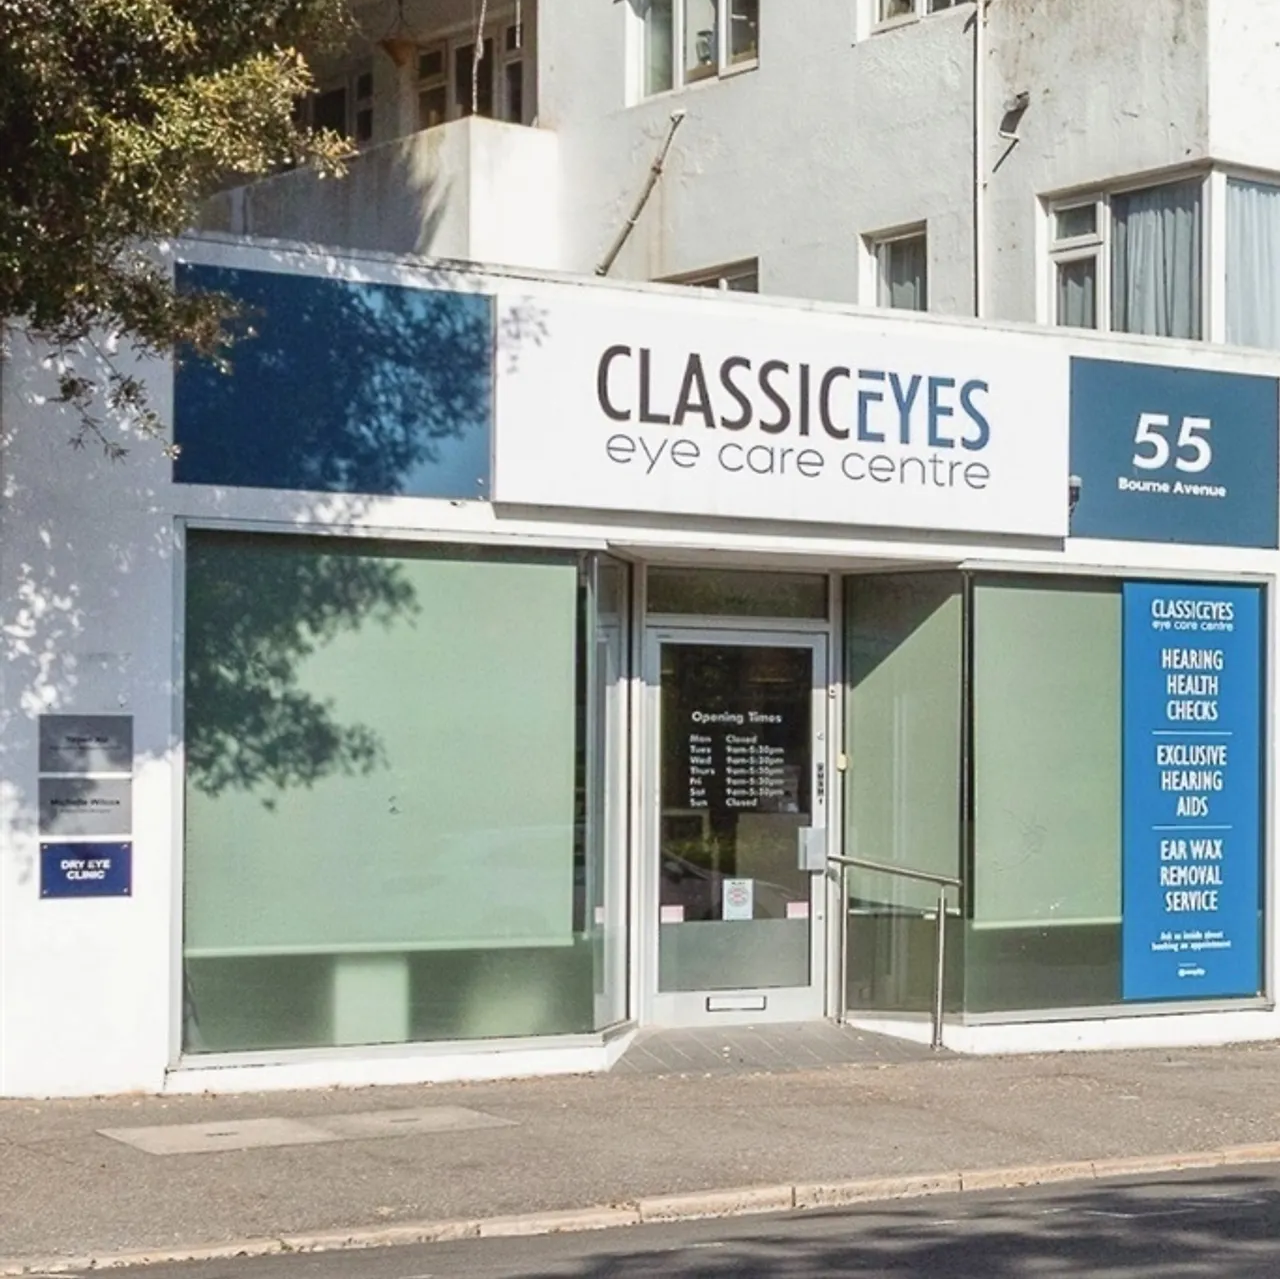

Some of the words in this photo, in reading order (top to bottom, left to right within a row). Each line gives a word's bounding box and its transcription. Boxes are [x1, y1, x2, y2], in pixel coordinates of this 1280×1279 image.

[597, 344, 991, 451] CLASSICEYES
[1132, 412, 1212, 473] 55
[606, 433, 700, 475] eye
[718, 442, 825, 477] care
[841, 452, 991, 489] centre
[1118, 476, 1170, 493] Bourne
[1173, 481, 1227, 497] Avenue
[1151, 599, 1234, 620] CLASSICEYES
[1152, 621, 1171, 631] eye
[1174, 621, 1197, 630] care
[1200, 621, 1234, 632] centre
[1162, 648, 1224, 670] HEARING
[1167, 674, 1218, 695] HEALTH
[691, 711, 744, 725] Opening
[748, 711, 782, 723] Times
[1167, 700, 1218, 721] CHECKS
[725, 734, 758, 743] Closed
[1157, 745, 1228, 766] EXCLUSIVE
[1161, 771, 1223, 791] HEARING
[1176, 796, 1209, 817] AIDS
[1161, 840, 1187, 861] EAR
[1190, 839, 1223, 860] WAX
[60, 858, 85, 870] DRY
[87, 858, 111, 869] EYE
[66, 869, 105, 880] CLINIC
[1160, 865, 1223, 886] REMOVAL
[1165, 891, 1218, 912] SERVICE
